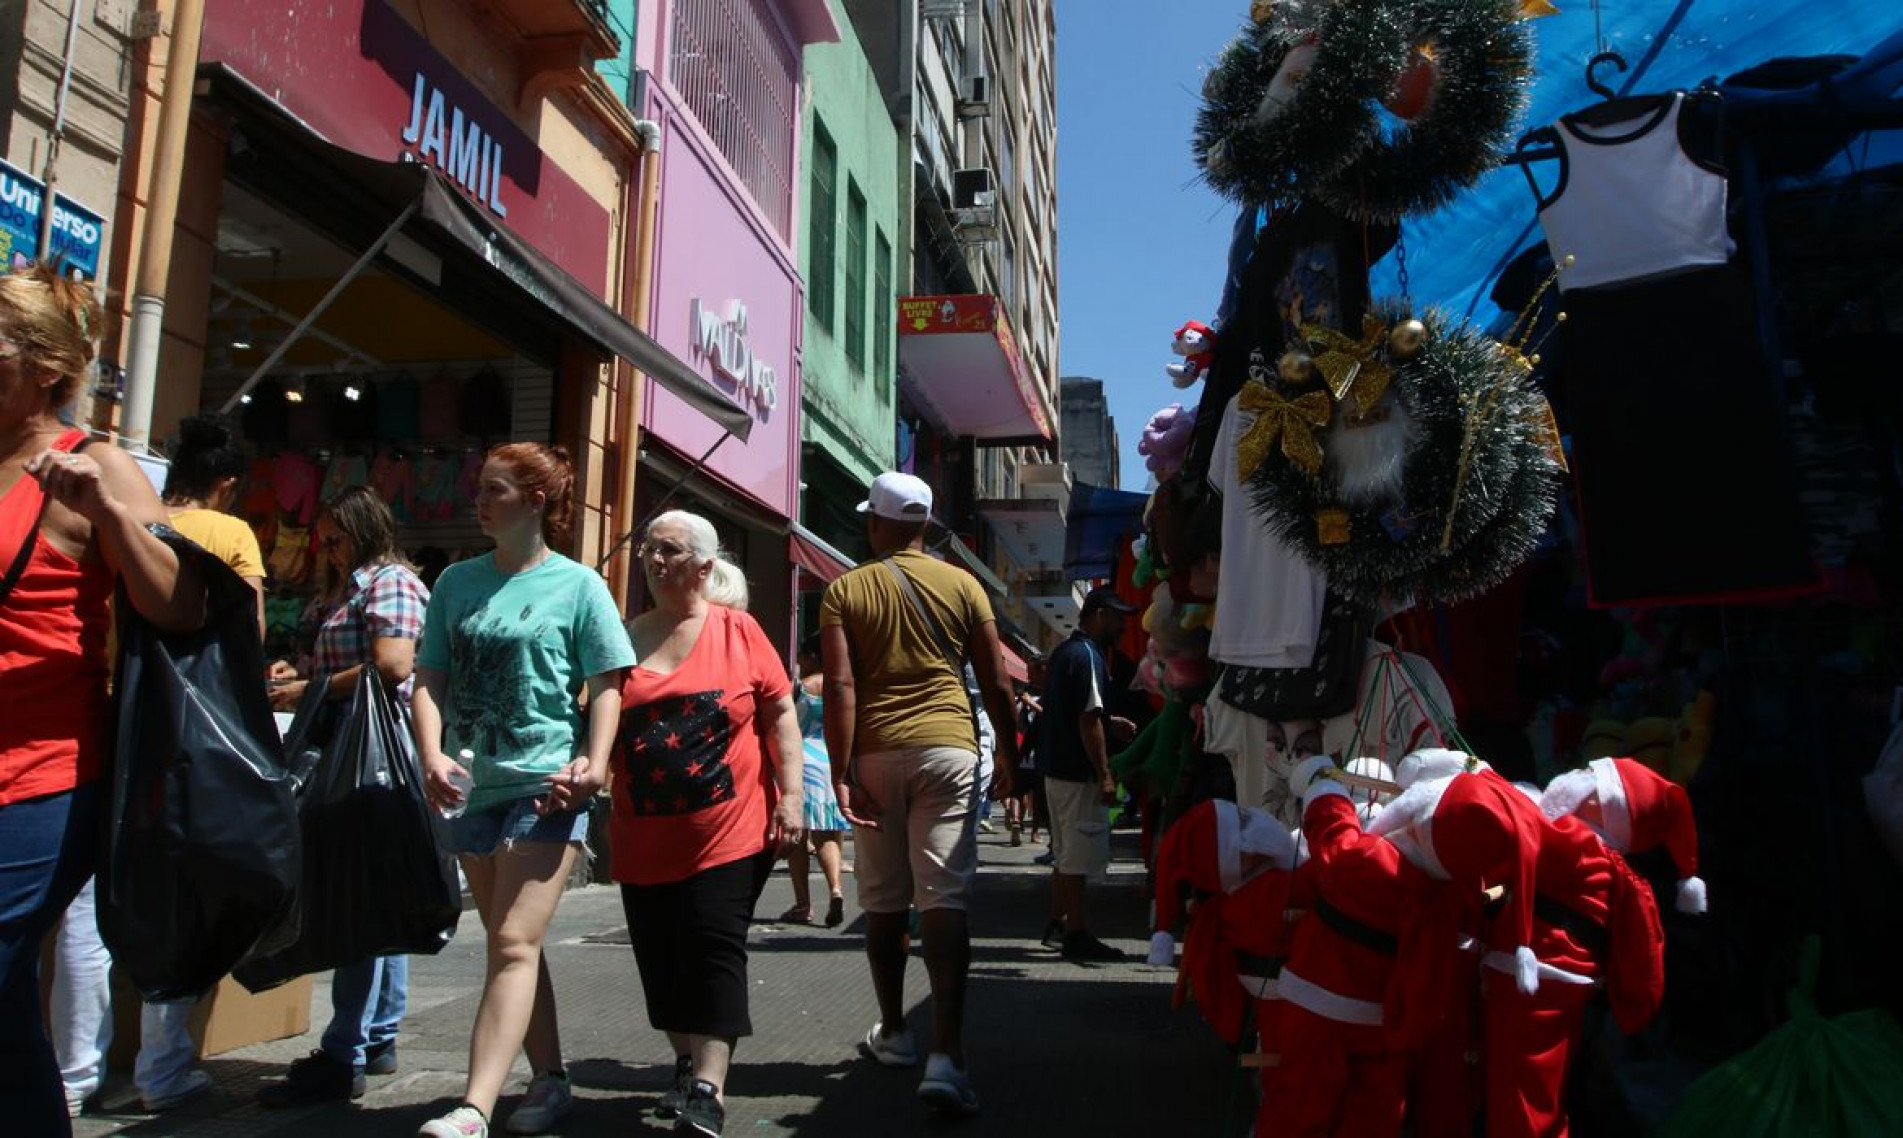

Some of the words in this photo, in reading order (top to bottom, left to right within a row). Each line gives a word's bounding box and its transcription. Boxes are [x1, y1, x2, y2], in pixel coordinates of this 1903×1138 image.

[402, 72, 506, 219] JAMIL
[0, 173, 98, 245] Unierso
[902, 301, 938, 310] BUFFET
[907, 309, 933, 318] LIVRE
